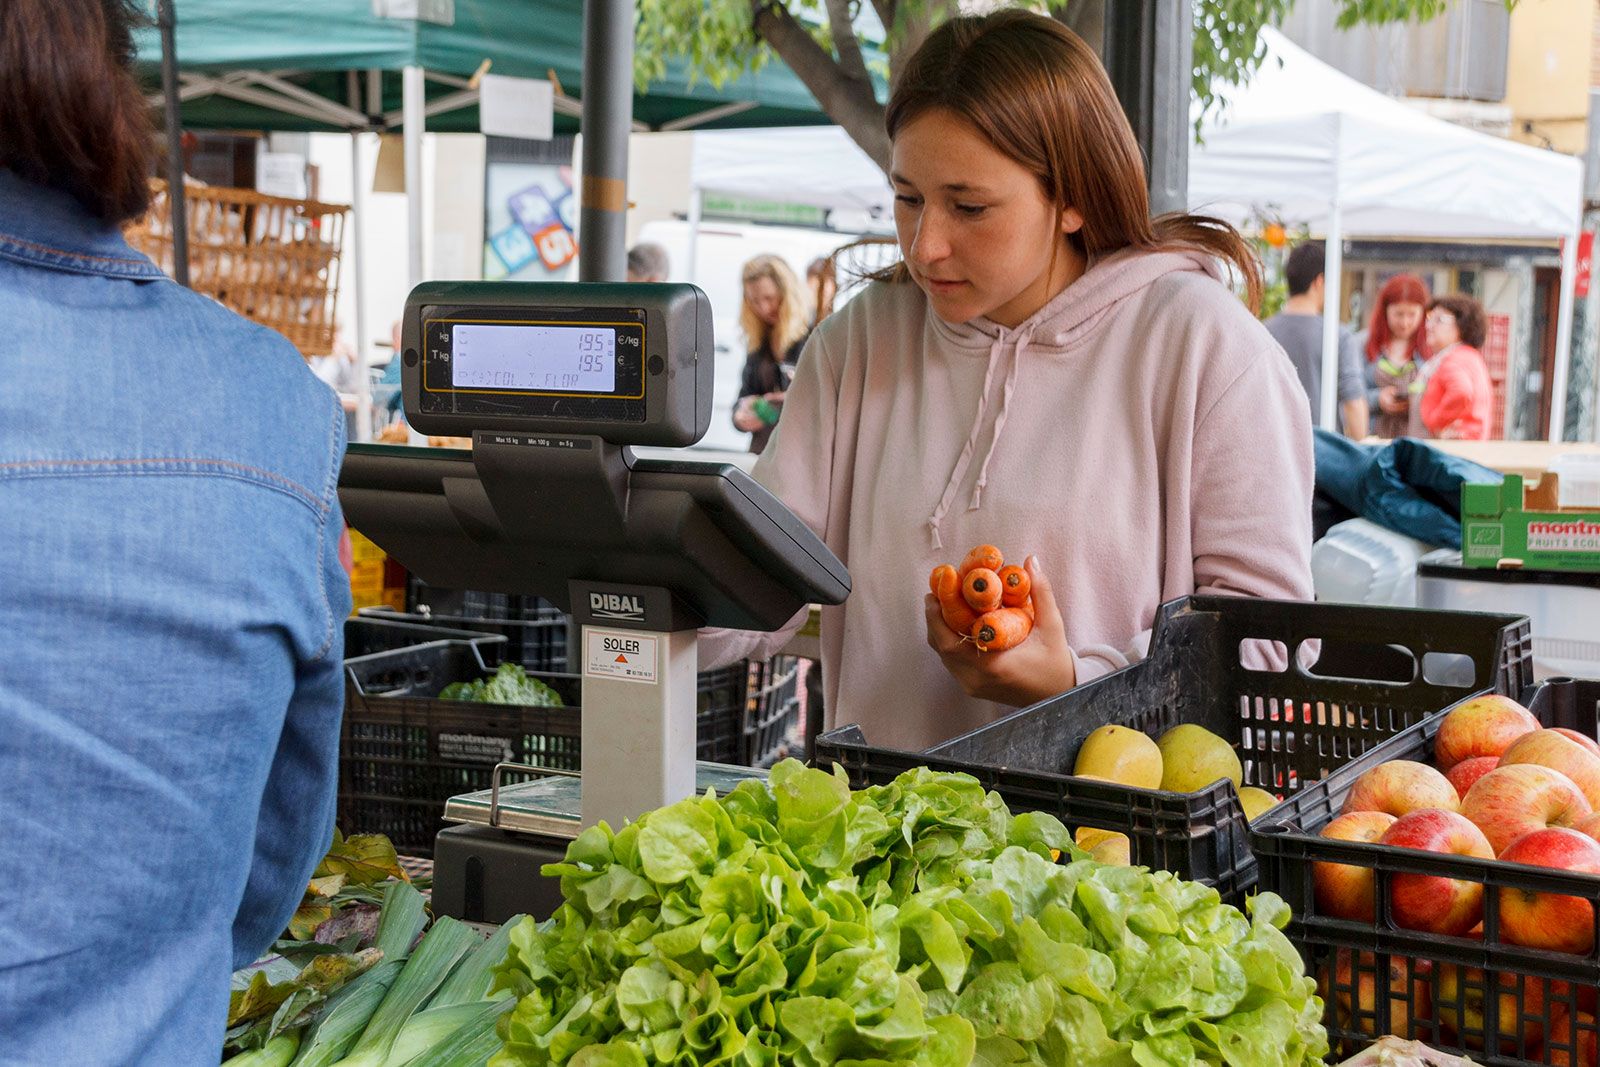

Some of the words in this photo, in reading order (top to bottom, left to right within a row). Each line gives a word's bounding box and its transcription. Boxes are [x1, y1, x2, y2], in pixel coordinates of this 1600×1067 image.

[440, 332, 449, 342] kg
[618, 335, 639, 347] €/kg
[432, 350, 438, 359] T
[440, 352, 449, 362] kg
[618, 355, 625, 365] €
[512, 437, 518, 445] kg
[1529, 519, 1600, 535] montm
[590, 592, 644, 613] DIBAL
[603, 637, 640, 652] SOLER
[439, 733, 510, 748] montmany
